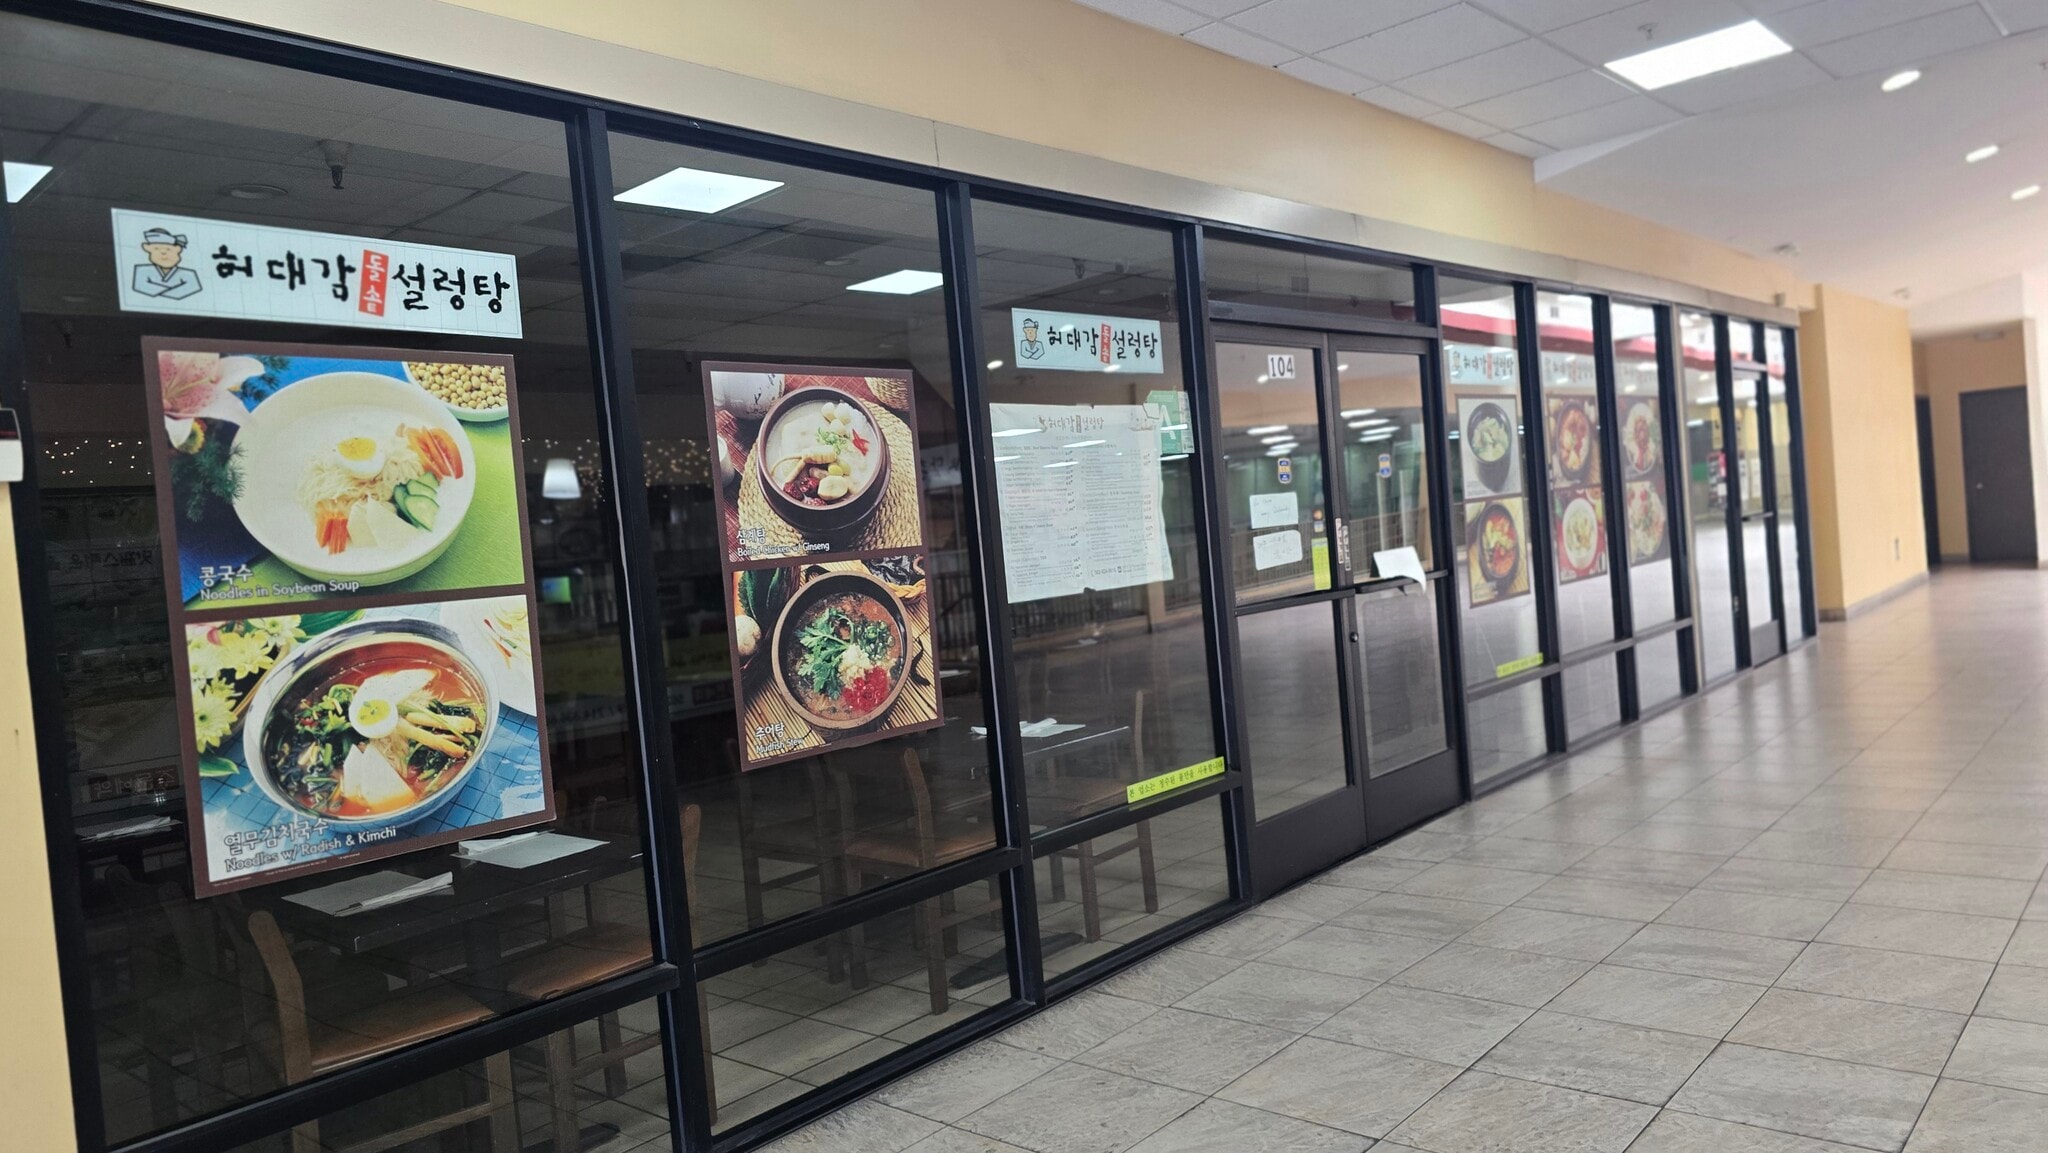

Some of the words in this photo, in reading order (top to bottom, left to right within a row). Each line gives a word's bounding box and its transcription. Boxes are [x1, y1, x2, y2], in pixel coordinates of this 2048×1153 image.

[211, 244, 357, 302] 허대감
[391, 262, 511, 314] 설렁탕
[1047, 325, 1099, 357] 허대감
[1112, 329, 1158, 360] 설렁탕
[1270, 356, 1294, 377] 104
[1159, 404, 1177, 439] A
[736, 528, 766, 545] 삼계탕
[737, 546, 761, 557] Boiled
[802, 542, 830, 552] Ginseng
[200, 564, 253, 587] 콩국수
[200, 586, 254, 601] Noodles
[256, 584, 269, 597] in
[272, 582, 326, 596] Soybean
[329, 579, 360, 592] Soup
[755, 722, 785, 740] 추어탕
[755, 741, 785, 754] Mudfish
[224, 817, 329, 857] 열무김치국수
[225, 851, 280, 873] Noodles
[281, 847, 298, 861] w/
[300, 838, 342, 857] Radish
[345, 834, 356, 847] &
[358, 826, 397, 844] Kimchi
